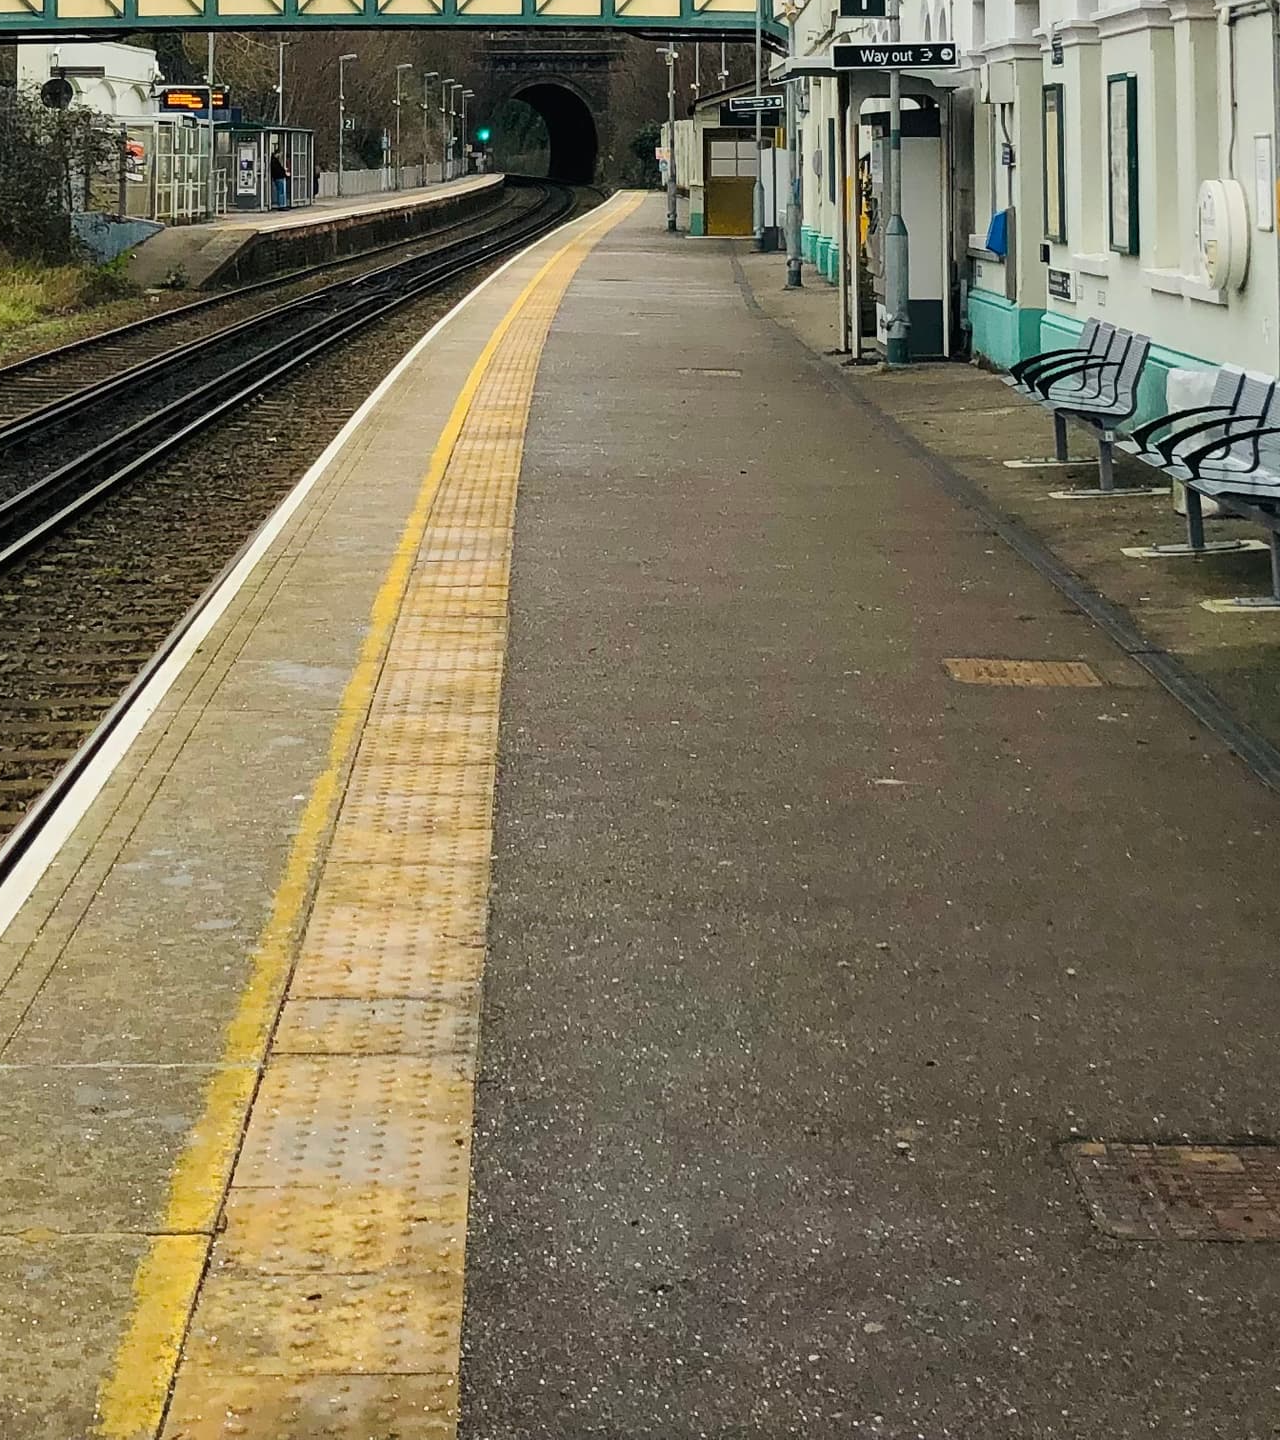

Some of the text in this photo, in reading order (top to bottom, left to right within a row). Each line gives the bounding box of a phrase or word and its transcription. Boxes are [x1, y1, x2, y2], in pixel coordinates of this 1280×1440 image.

[860, 49, 913, 66] Way out
[345, 119, 351, 129] 2
